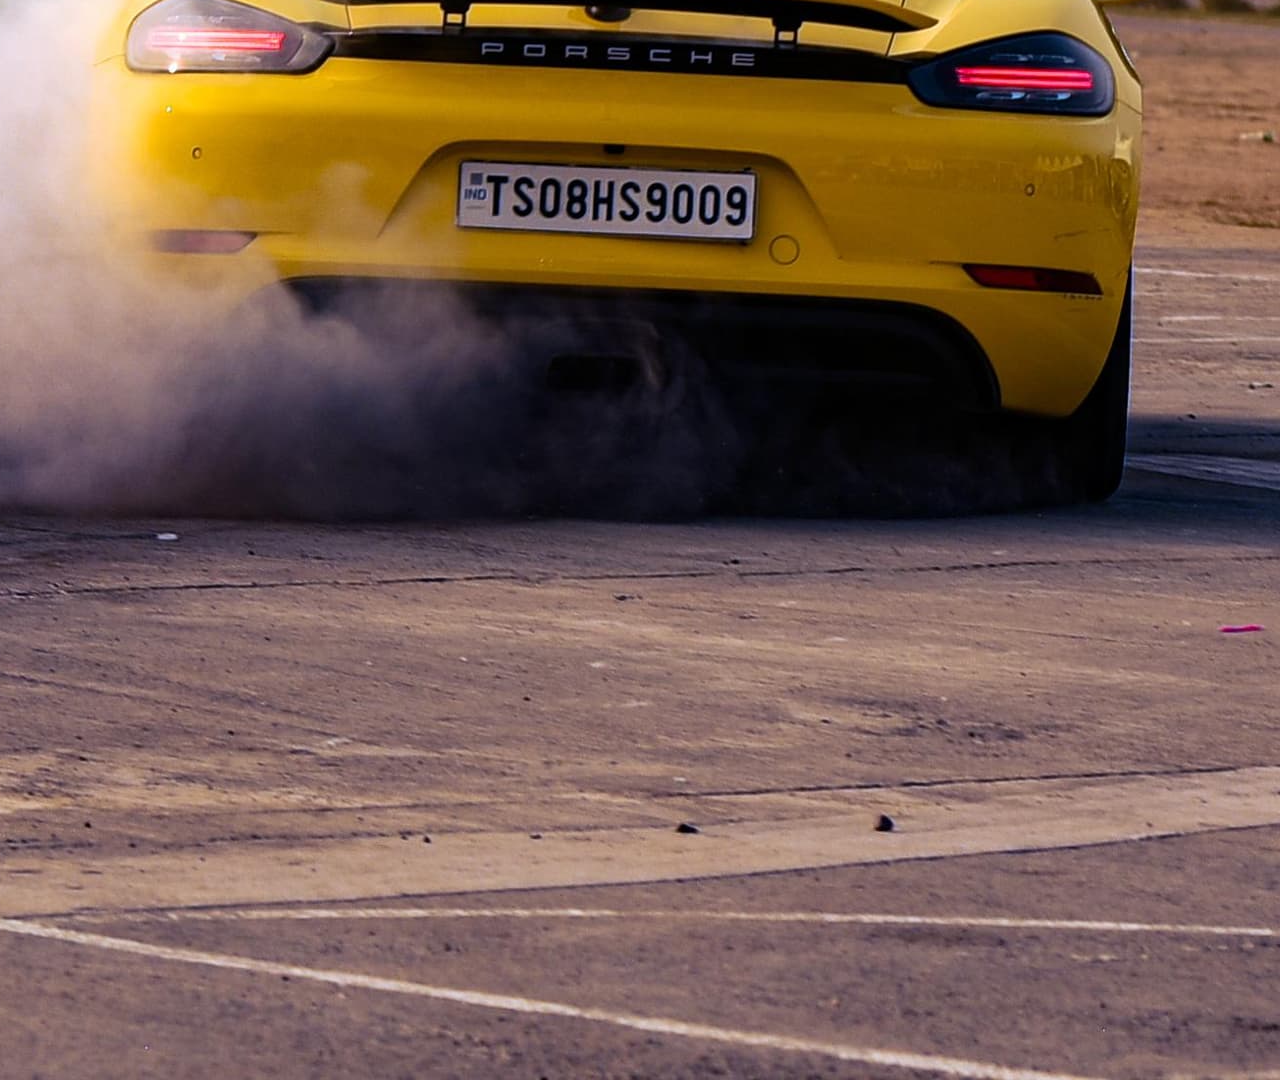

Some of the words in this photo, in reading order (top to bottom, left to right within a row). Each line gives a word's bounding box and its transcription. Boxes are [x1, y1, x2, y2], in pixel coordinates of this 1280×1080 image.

[481, 42, 755, 66] PORSCHE
[464, 187, 487, 200] IND
[487, 175, 748, 227] TS08HS9009
